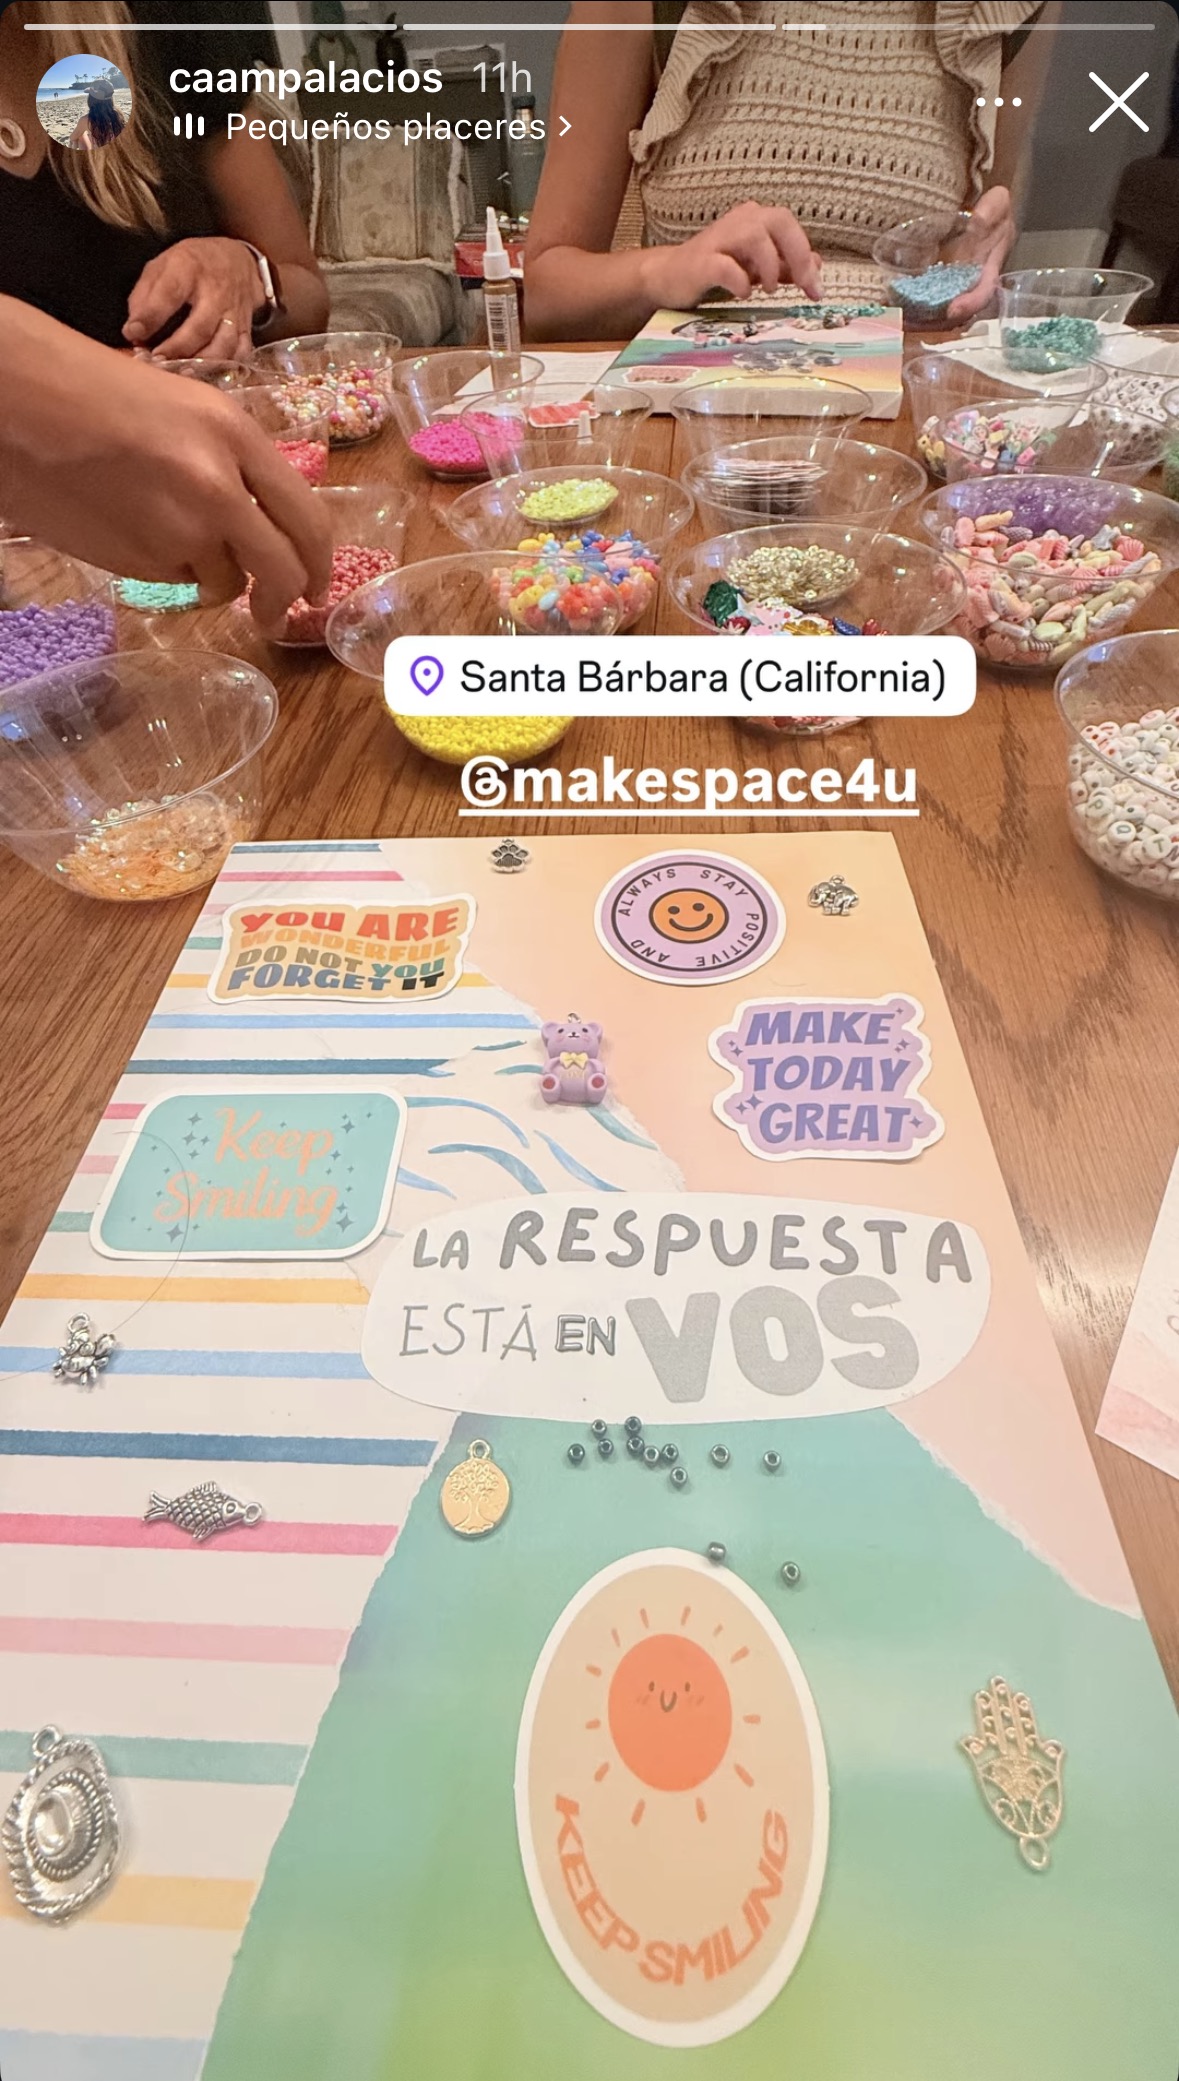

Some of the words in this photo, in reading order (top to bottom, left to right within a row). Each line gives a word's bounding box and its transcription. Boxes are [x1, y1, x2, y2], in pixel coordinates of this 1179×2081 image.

[618, 868, 677, 917] ALWAYS
[700, 869, 749, 898] STAY
[240, 911, 346, 933] YOU
[356, 907, 460, 942] ARE
[695, 912, 760, 967] POSITIVE
[235, 945, 288, 968] DO
[295, 946, 363, 973] NOT
[371, 958, 446, 979] YOU
[240, 927, 451, 963] WONDERFUL
[630, 939, 671, 964] AND
[227, 963, 392, 991] FORGET
[401, 971, 445, 991] IT
[745, 1010, 896, 1047] MAKE
[747, 1055, 911, 1092] TODAY
[214, 1106, 334, 1176] Keep
[759, 1102, 912, 1144] GREAT
[153, 1166, 339, 1238] Smiling
[413, 1228, 470, 1270] LA
[499, 1207, 973, 1283] RESPUESTA
[399, 1302, 537, 1362] ESTÁ
[555, 1315, 616, 1357] EN
[625, 1275, 920, 1403] VOS
[555, 1794, 641, 1952] KEEP
[638, 1808, 789, 1986] SMILING
